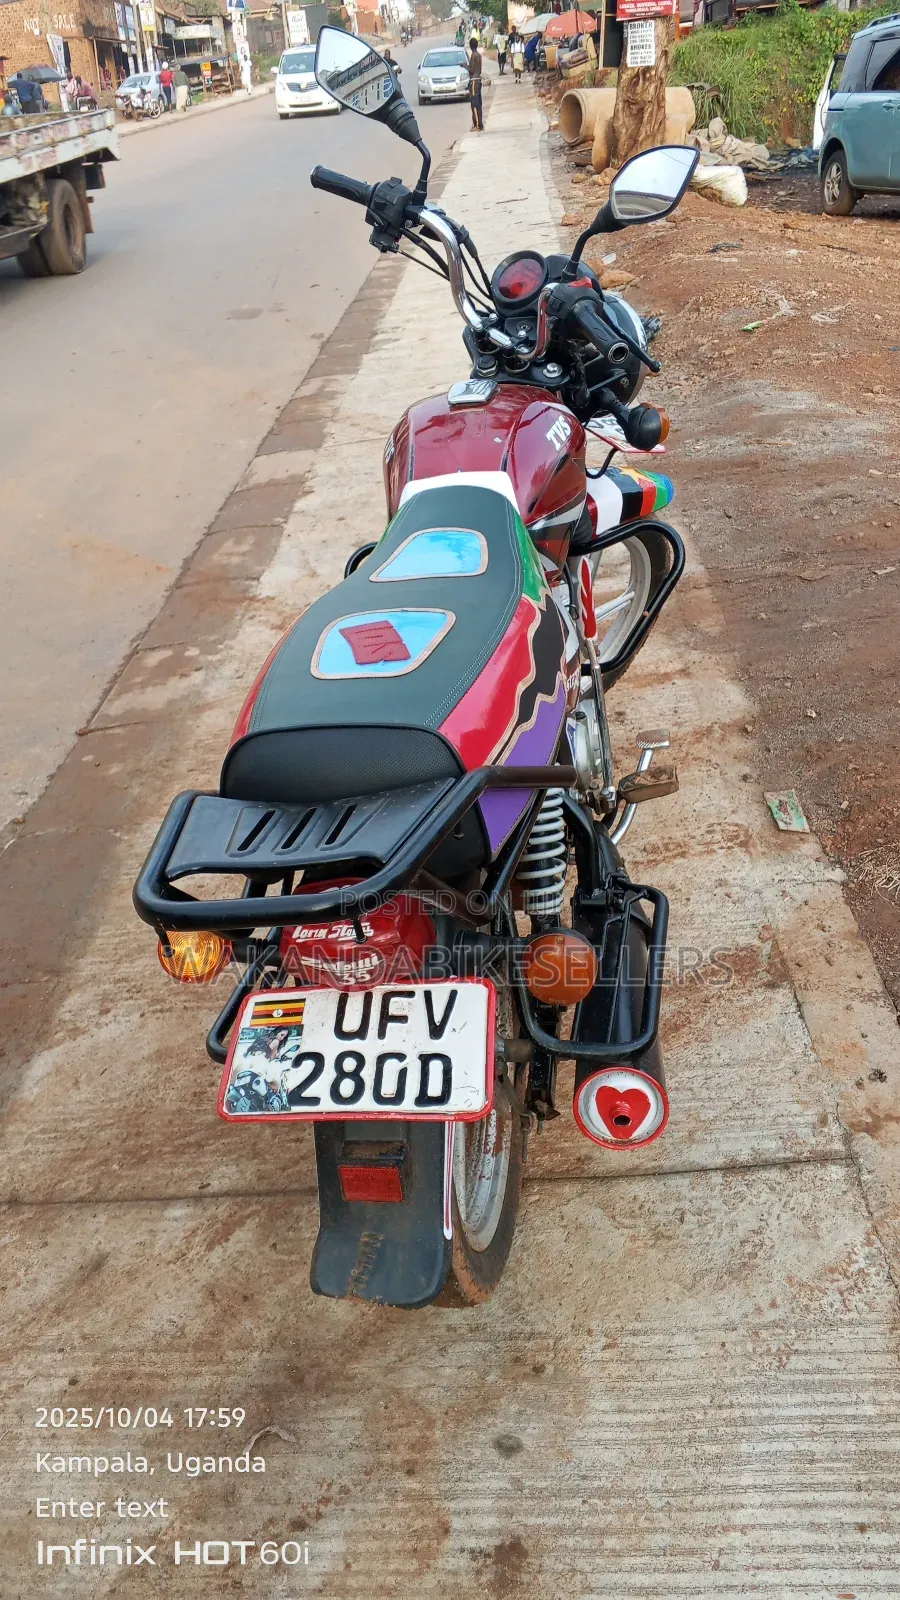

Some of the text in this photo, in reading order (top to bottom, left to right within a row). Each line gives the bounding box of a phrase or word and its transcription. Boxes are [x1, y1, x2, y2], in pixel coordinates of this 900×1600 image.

[629, 21, 653, 30] BROKER
[545, 415, 572, 452] TVS
[334, 990, 459, 1041] UFV
[289, 1050, 453, 1107] 280D
